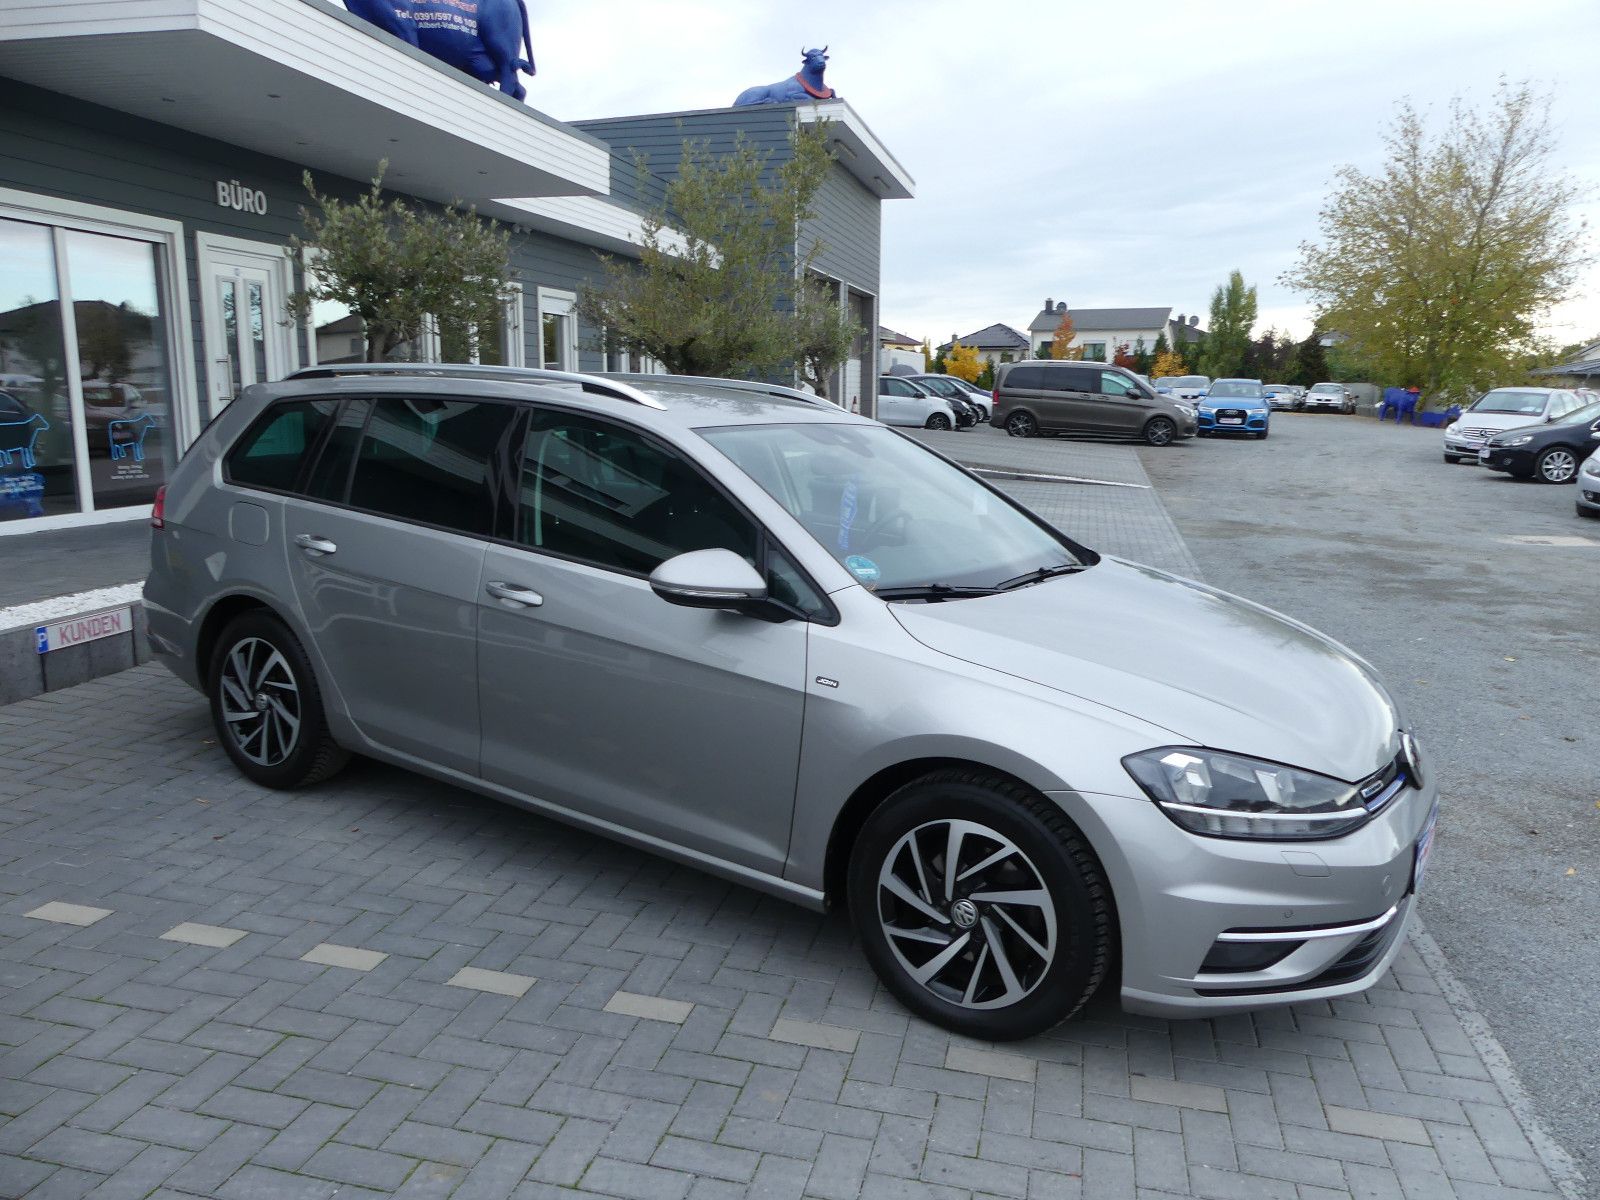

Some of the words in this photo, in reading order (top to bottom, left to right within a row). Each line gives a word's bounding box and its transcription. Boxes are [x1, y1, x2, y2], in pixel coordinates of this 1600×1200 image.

[394, 9, 412, 19] Tel.
[216, 179, 267, 216] BÜRO
[59, 612, 121, 645] KUNDEN
